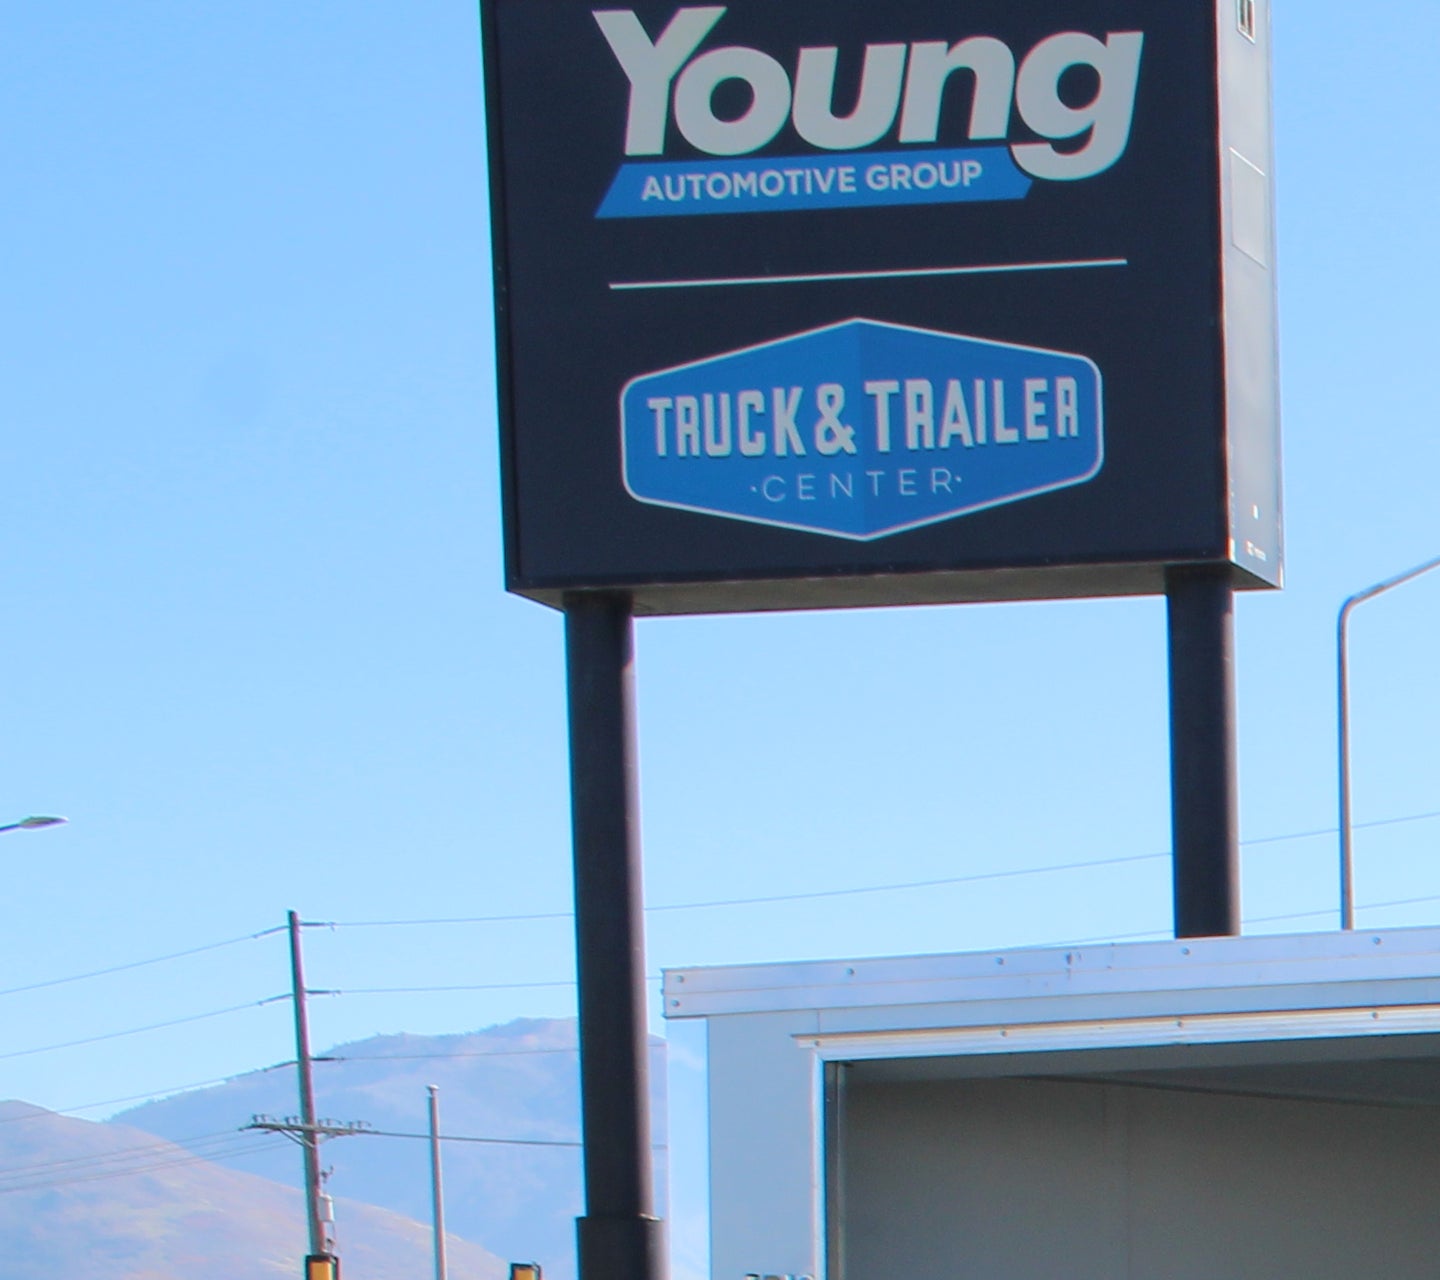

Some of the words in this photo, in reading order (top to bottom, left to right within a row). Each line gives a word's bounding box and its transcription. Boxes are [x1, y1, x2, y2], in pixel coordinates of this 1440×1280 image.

[592, 6, 1144, 181] Young
[641, 167, 857, 201] AUTOMOTIVE
[865, 160, 983, 191] GROUP
[647, 386, 807, 458] TRUCK
[814, 383, 858, 455] &
[864, 376, 1080, 453] TRAILER
[761, 468, 953, 502] CENTER
